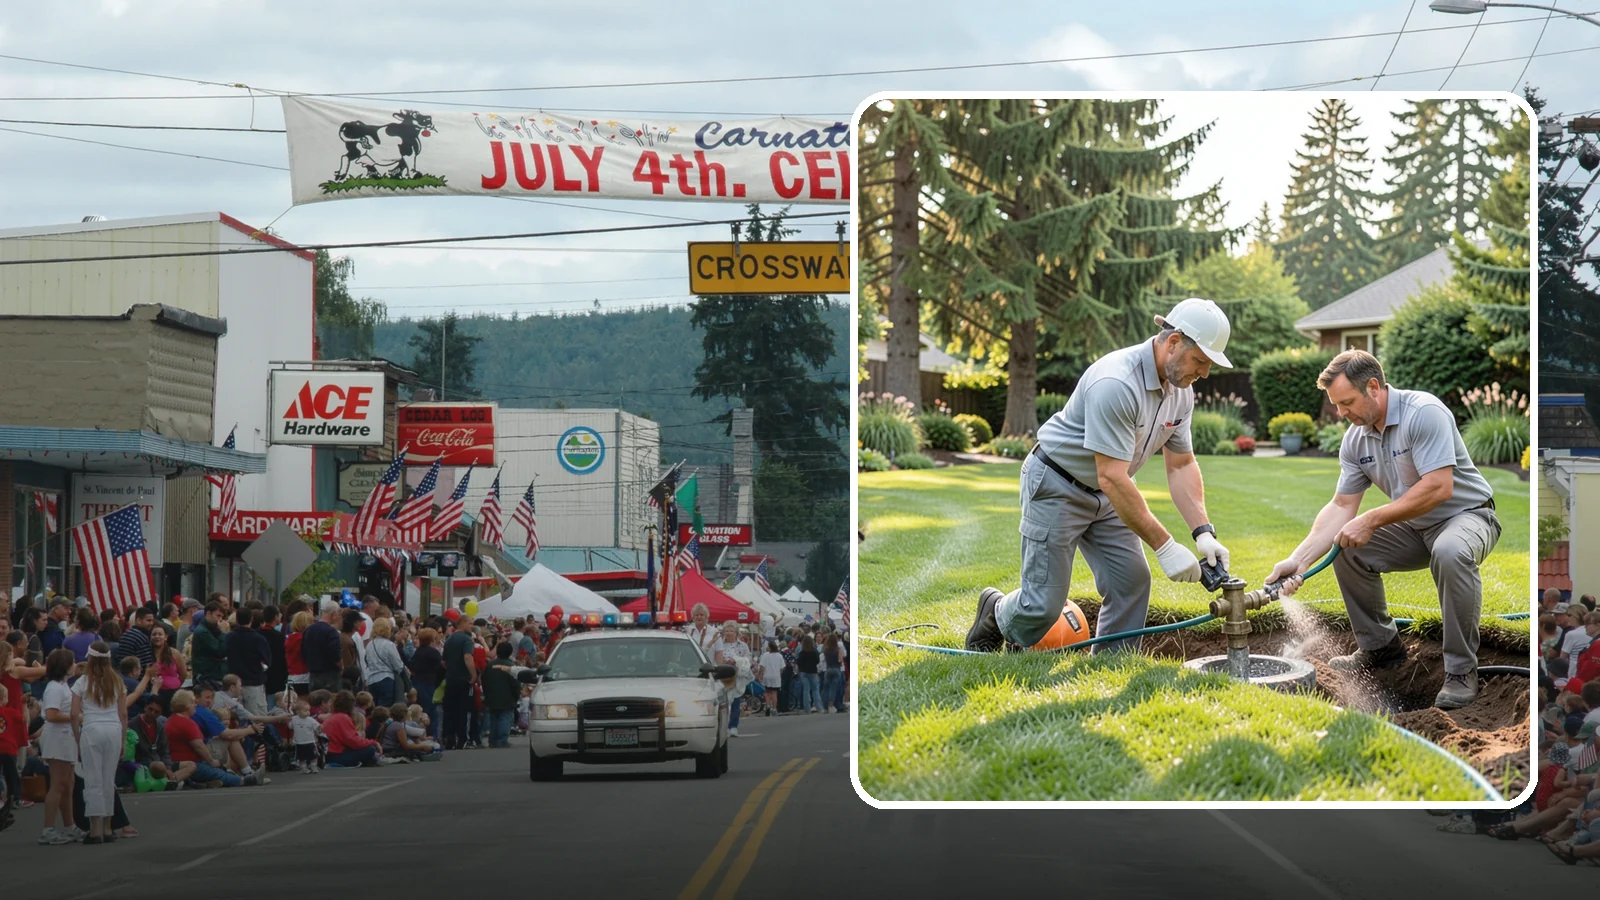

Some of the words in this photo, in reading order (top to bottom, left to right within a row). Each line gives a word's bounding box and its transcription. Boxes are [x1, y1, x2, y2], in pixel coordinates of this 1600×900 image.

[481, 141, 605, 192] JULY
[632, 150, 746, 198] 4th.
[697, 254, 850, 280] CROSSWA
[283, 380, 373, 420] ACE
[406, 409, 452, 422] CEDAR
[461, 409, 485, 422] LOG
[284, 421, 371, 436] Hardware
[416, 428, 477, 447] Coca-Cola
[83, 485, 93, 494] St.
[95, 485, 124, 495] Vincent
[126, 486, 136, 495] de
[137, 486, 155, 495] Paul
[699, 535, 730, 544] GLASS
